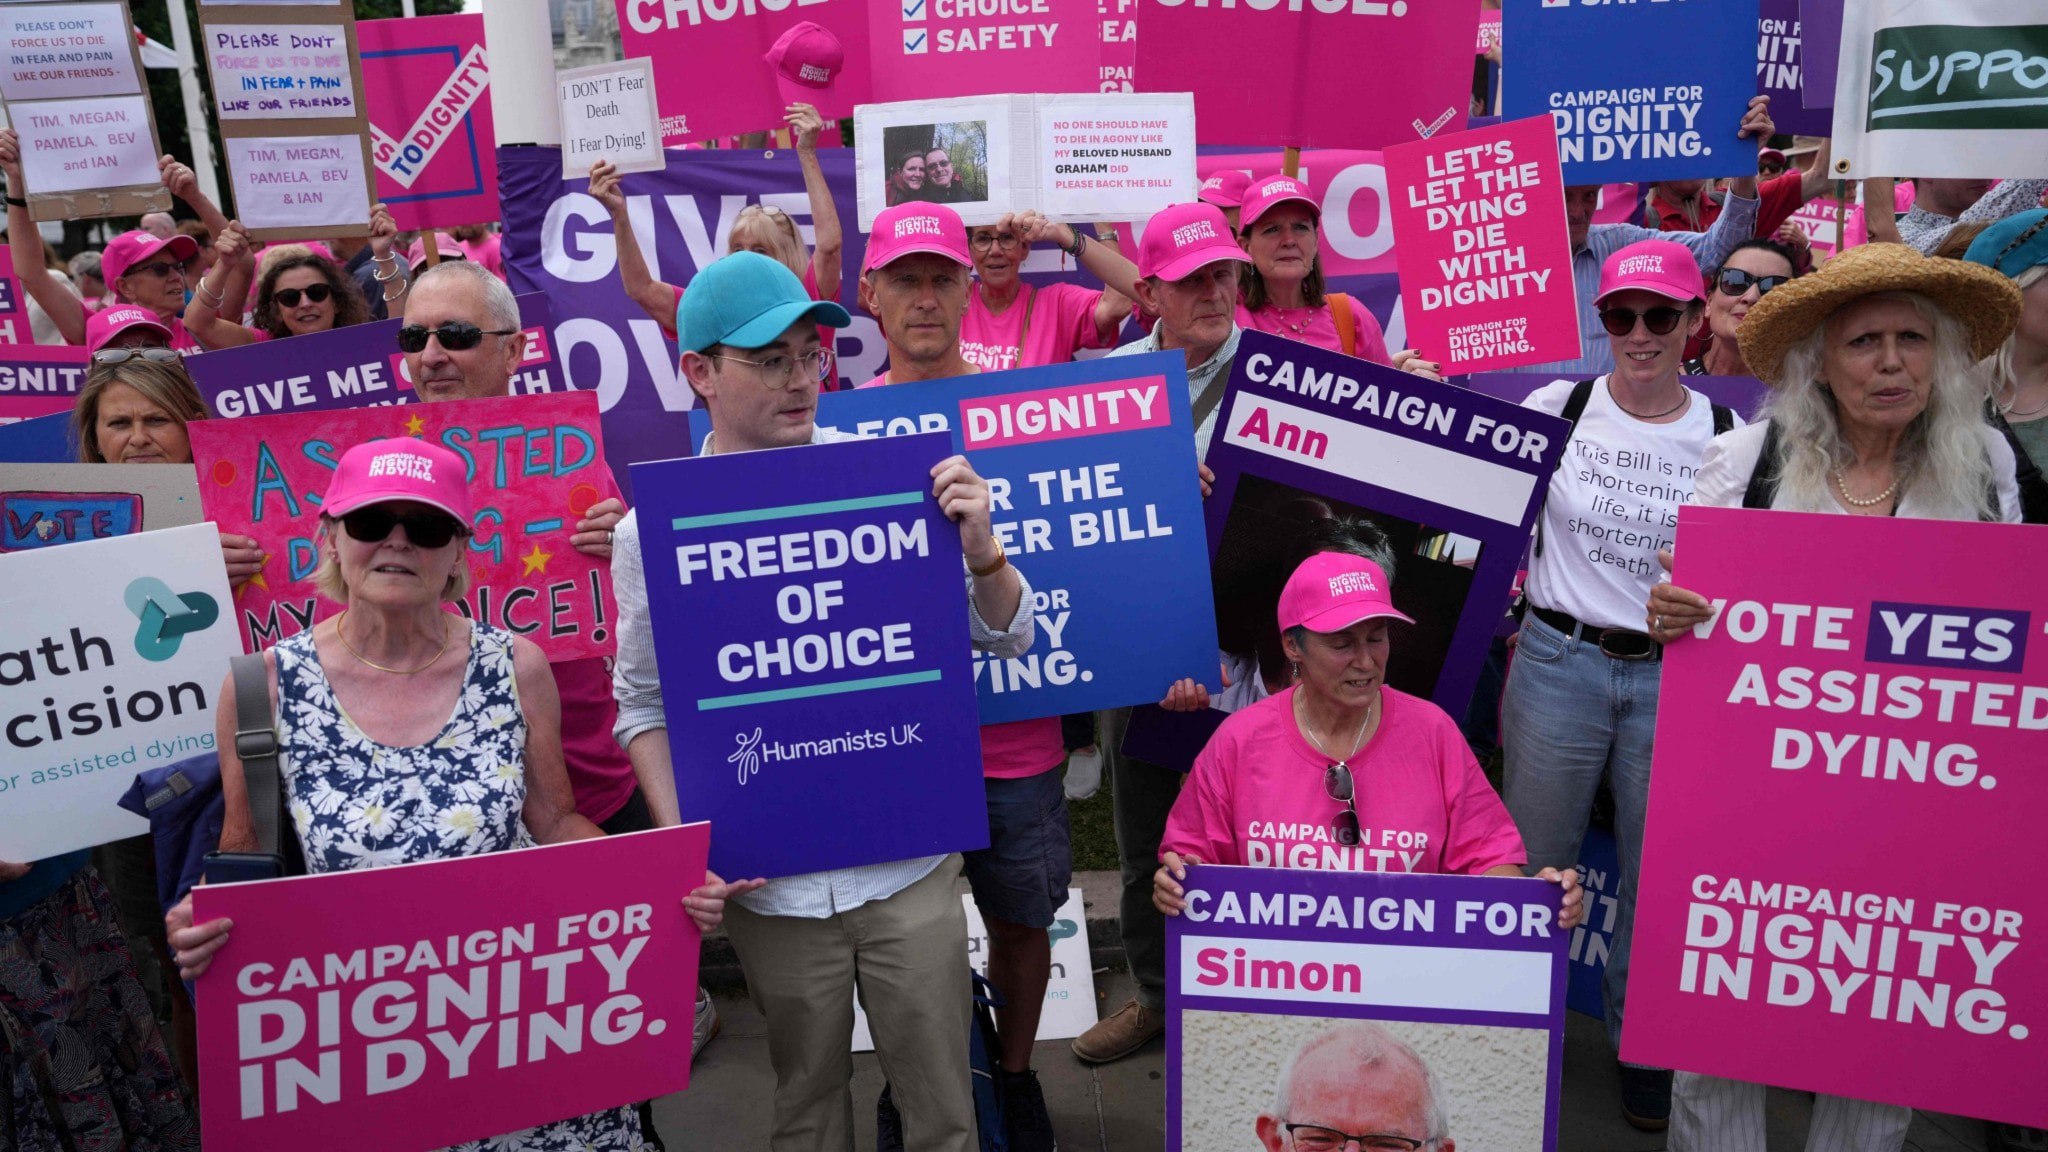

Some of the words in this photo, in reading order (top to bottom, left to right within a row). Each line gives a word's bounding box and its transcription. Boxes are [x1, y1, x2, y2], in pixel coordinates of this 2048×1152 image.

[15, 22, 56, 32] PLEASE
[59, 20, 94, 30] DON'T
[936, 23, 1059, 53] SAFETY
[12, 38, 48, 48] FORCE
[51, 38, 66, 46] US
[70, 37, 84, 46] TO
[88, 36, 105, 45] DIE
[217, 33, 280, 48] PLEASE
[12, 56, 24, 64] IN
[27, 54, 55, 64] FEAR
[58, 53, 83, 62] AND
[86, 52, 113, 61] PAIN
[266, 56, 284, 68] US
[290, 56, 310, 67] TO
[315, 55, 341, 68] DIE
[13, 72, 37, 82] LIKE
[40, 70, 65, 80] OUR
[68, 68, 114, 78] FRIENDS
[242, 77, 258, 90] IN
[262, 76, 294, 90] FEAR
[310, 77, 341, 88] PAIN
[572, 79, 612, 98] DON'T
[618, 76, 644, 92] Fear
[222, 100, 250, 111] LIKE
[259, 100, 282, 110] OUR
[290, 97, 351, 108] FRIENDS
[1550, 88, 1656, 108] CAMPAIGN
[1664, 86, 1703, 102] FOR
[1072, 121, 1094, 129] ONE
[1096, 121, 1138, 129] SHOULD
[1141, 120, 1168, 129] HAVE
[1552, 102, 1702, 134] DIGNITY
[108, 132, 136, 145] BEV
[580, 138, 602, 152] Fear
[605, 132, 646, 152] Dying!
[1054, 135, 1067, 143] TO
[1070, 135, 1087, 143] DIE
[1090, 135, 1100, 143] IN
[1103, 135, 1139, 143] AGONY
[1142, 134, 1163, 142] LIKE
[1592, 131, 1712, 161] DYING.
[64, 159, 87, 171] and
[92, 156, 118, 168] IAN
[248, 150, 280, 162] TIM,
[286, 148, 344, 160] MEGAN,
[1055, 150, 1070, 158] MY
[1072, 149, 1119, 157] BELOVED
[1121, 148, 1172, 157] HUSBAND
[322, 170, 348, 182] BEV
[1055, 164, 1107, 173] GRAHAM
[1110, 165, 1128, 173] DID
[284, 194, 294, 204] &
[298, 192, 323, 204] IAN
[1056, 180, 1094, 189] PLEASE
[1096, 180, 1123, 188] BACK
[1148, 179, 1172, 187] BILL!
[1408, 176, 1465, 208] LET
[1474, 162, 1540, 195] THE
[1427, 192, 1527, 231] DYING
[895, 220, 940, 232] DIGNITY
[907, 227, 944, 236] DYING.
[1174, 225, 1211, 241] DIGNITY
[1453, 223, 1506, 253] DIE
[1176, 240, 1186, 248] IN
[1438, 246, 1526, 281] WITH
[1618, 268, 1627, 277] IN
[1628, 266, 1664, 274] DYING.
[1619, 258, 1662, 270] DIGNITY
[1421, 269, 1552, 311] DIGNITY
[1448, 320, 1502, 336] CAMPAIGN
[1506, 317, 1527, 327] FOR
[1449, 326, 1527, 349] DIGNITY
[1451, 346, 1469, 362] IN
[1473, 340, 1535, 360] DYING.
[216, 375, 316, 419] GIVE
[326, 362, 388, 398] ME
[967, 386, 1159, 442] DIGNITY
[1245, 353, 1456, 436] CAMPAIGN
[1465, 414, 1549, 464] FOR
[1238, 406, 1329, 460] Ann
[369, 468, 384, 477] IN
[386, 467, 436, 483] DYING.
[371, 459, 432, 472] DIGNITY
[1616, 451, 1651, 470] Bill
[1658, 457, 1673, 475] is
[1028, 463, 1123, 506] THE
[1070, 504, 1172, 547] BILL
[1592, 495, 1629, 522] life,
[1638, 504, 1653, 523] it
[1661, 508, 1678, 528] is
[1568, 518, 1673, 554] shortenin
[675, 518, 929, 585] FREEDOM
[1589, 547, 1653, 576] death.
[1329, 576, 1371, 588] DIGNITY
[1331, 588, 1343, 597] IN
[1345, 583, 1378, 593] DYING.
[777, 579, 844, 625] OF
[245, 598, 316, 654] MY
[1692, 598, 1854, 651] VOTE
[1879, 610, 2016, 663] YES
[717, 623, 914, 682] CHOICE
[1726, 663, 2048, 731] ASSISTED
[762, 727, 887, 764] Humanists
[892, 722, 923, 746] UK
[31, 746, 137, 784] assisted
[146, 732, 215, 758] dying
[1771, 728, 1996, 790] DYING.
[1249, 821, 1370, 845] CAMPAIGN
[1382, 830, 1428, 849] FOR
[1247, 840, 1425, 873] DIGNITY
[1183, 889, 1435, 932] CAMPAIGN
[1454, 900, 1552, 938] FOR
[1691, 874, 1915, 924] CAMPAIGN
[1932, 902, 2023, 938] FOR
[236, 922, 534, 997] CAMPAIGN
[557, 903, 653, 942] FOR
[1685, 901, 2020, 986] DIGNITY
[1196, 947, 1362, 993] Simon
[237, 935, 652, 1062] DIGNITY
[1679, 949, 1753, 1000] IN
[1766, 960, 2028, 1040] DYING.
[240, 1050, 340, 1121] IN
[366, 994, 668, 1096] DYING.
